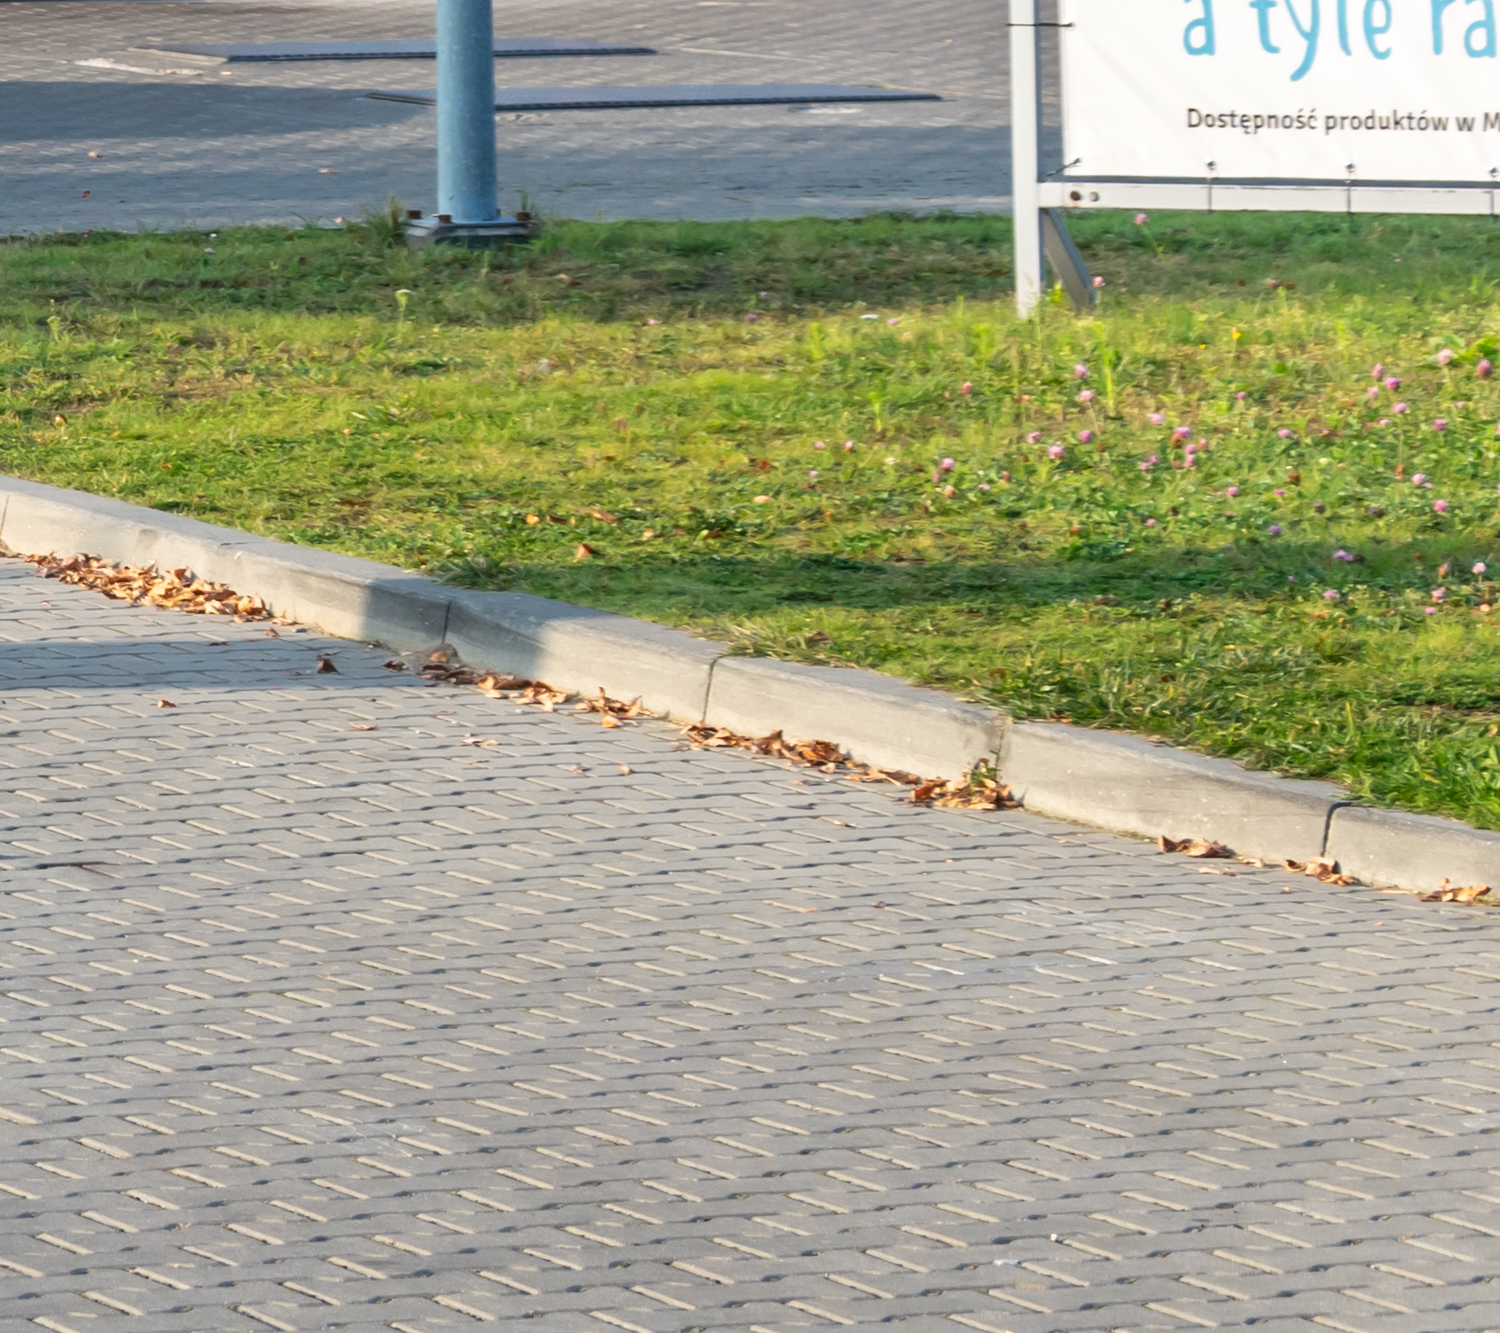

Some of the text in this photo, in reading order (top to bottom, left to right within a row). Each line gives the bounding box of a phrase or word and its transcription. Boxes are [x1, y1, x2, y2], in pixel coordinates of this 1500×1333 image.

[1187, 108, 1317, 134] Dostępność
[1325, 110, 1449, 135] produktów
[1455, 118, 1476, 132] w
